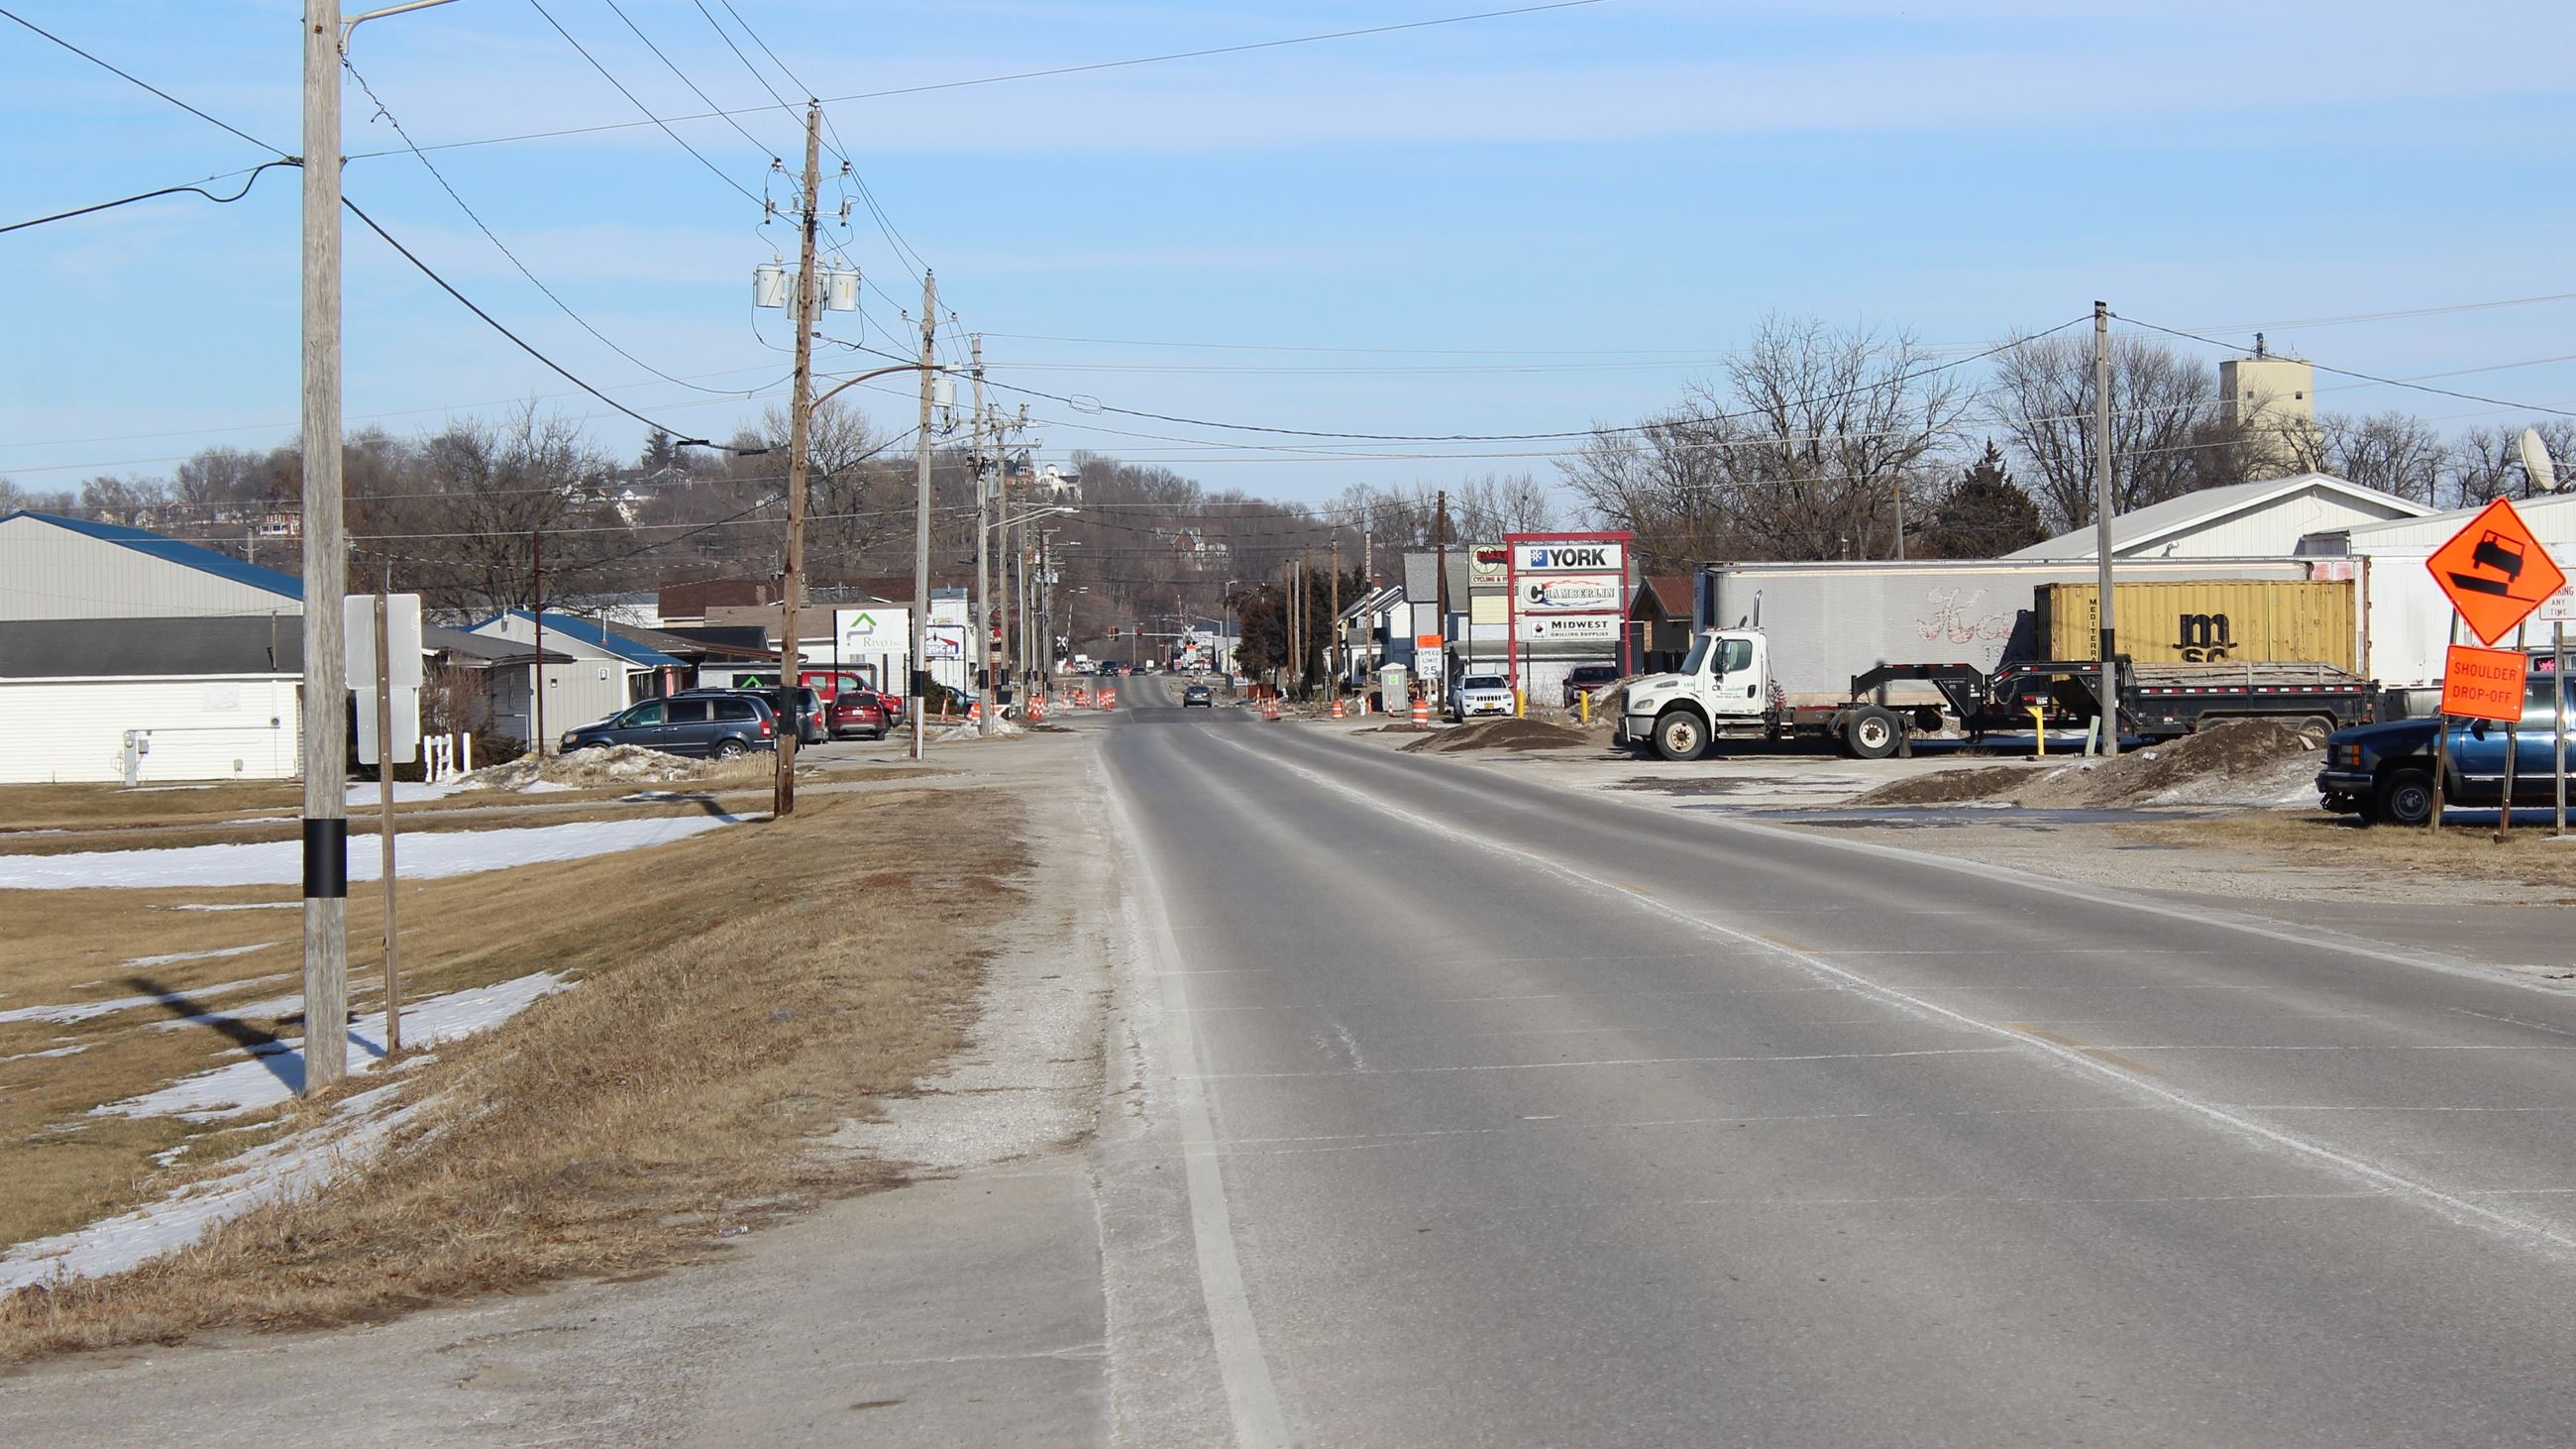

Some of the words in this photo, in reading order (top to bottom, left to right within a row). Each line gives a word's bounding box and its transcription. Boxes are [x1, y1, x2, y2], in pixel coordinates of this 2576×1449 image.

[1549, 548, 1607, 567] YORK
[1551, 620, 1608, 629] MIDWEST
[1424, 666, 1438, 675] 25
[2454, 661, 2517, 682] SHOULDER
[2452, 685, 2513, 703] DROP-OFF
